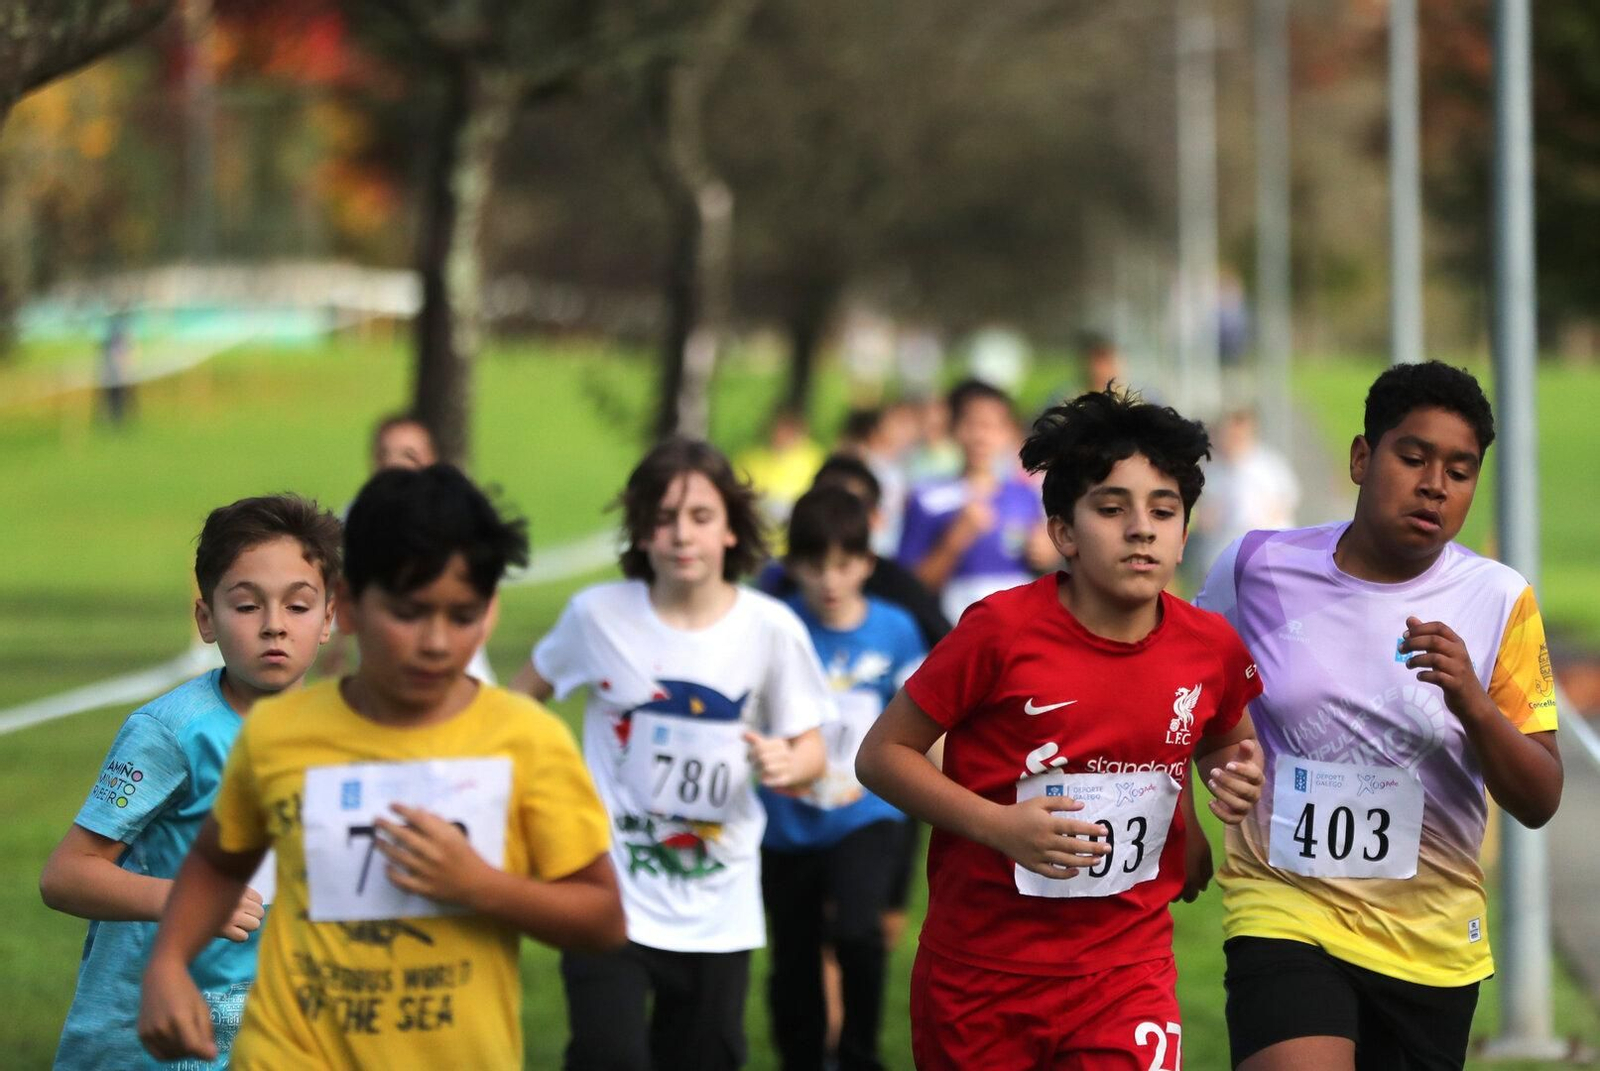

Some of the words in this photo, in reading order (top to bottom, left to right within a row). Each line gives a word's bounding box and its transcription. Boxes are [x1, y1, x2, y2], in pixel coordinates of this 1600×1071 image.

[653, 754, 731, 808] 780
[1316, 773, 1345, 781] DEPORTE
[1316, 780, 1343, 789] GALEGO
[1293, 802, 1390, 862] 403
[396, 994, 453, 1031] SEA
